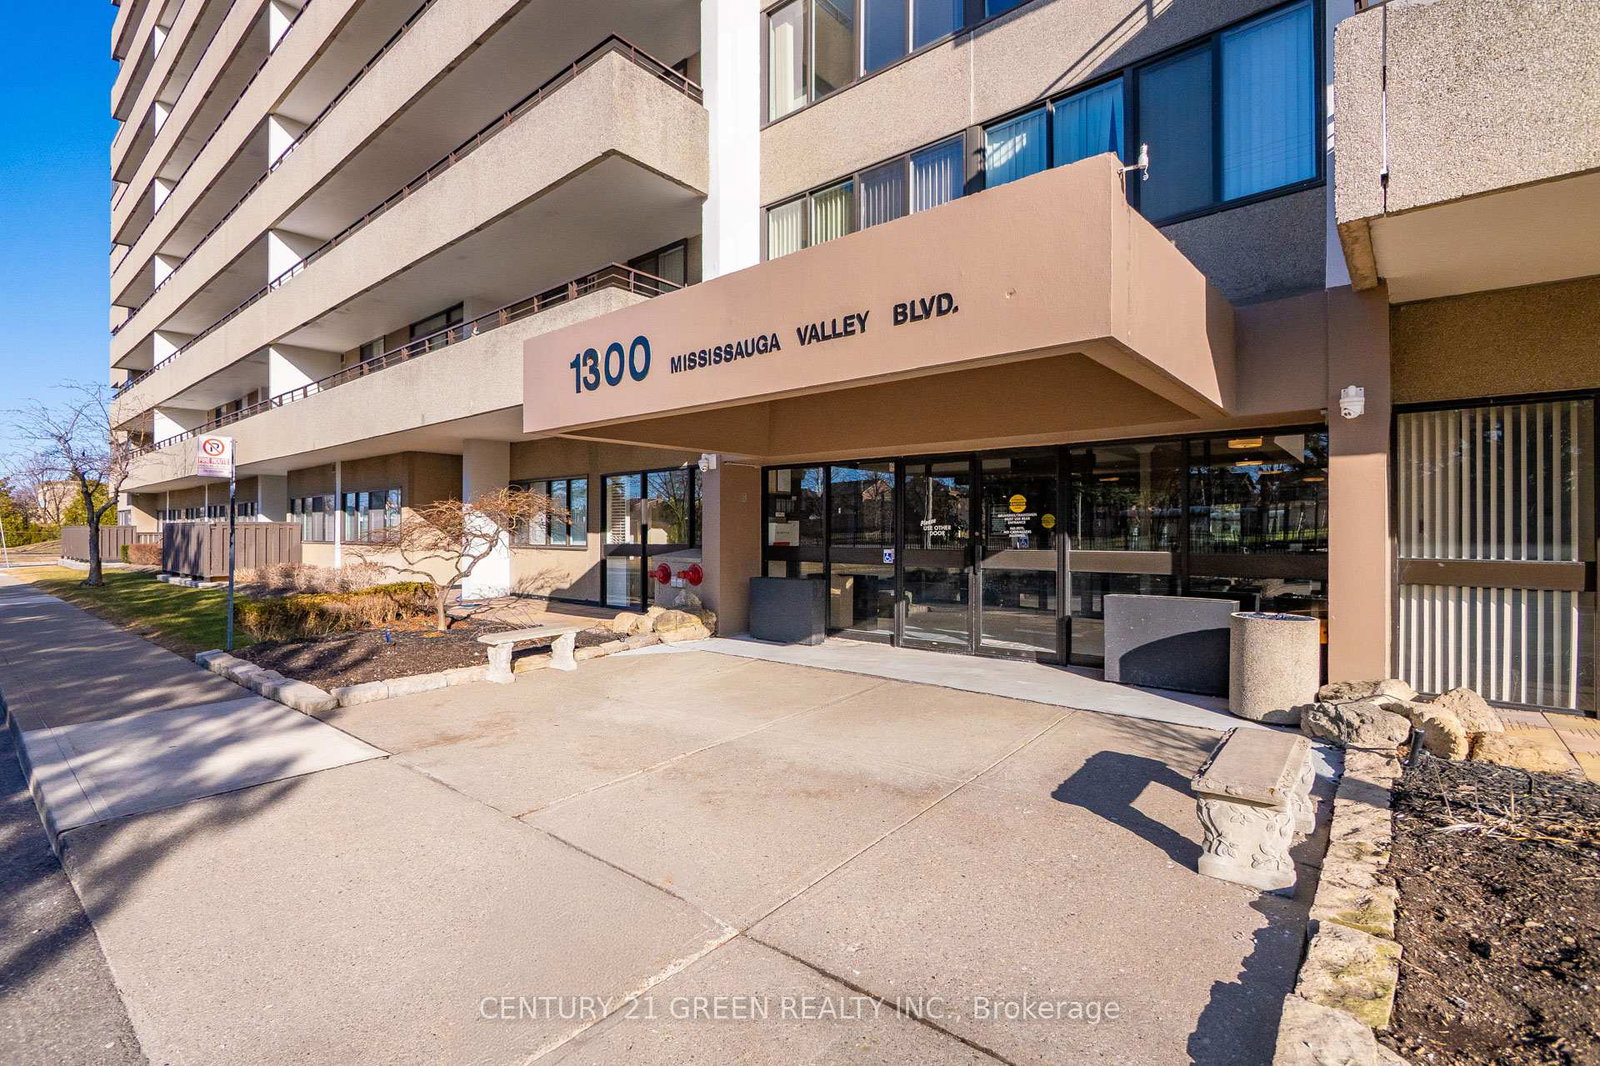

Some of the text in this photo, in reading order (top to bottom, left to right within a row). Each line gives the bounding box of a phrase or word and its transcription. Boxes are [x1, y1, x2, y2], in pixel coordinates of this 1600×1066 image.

[570, 292, 959, 394] 1300 MISSISSAUGA VALLEY BLVD.
